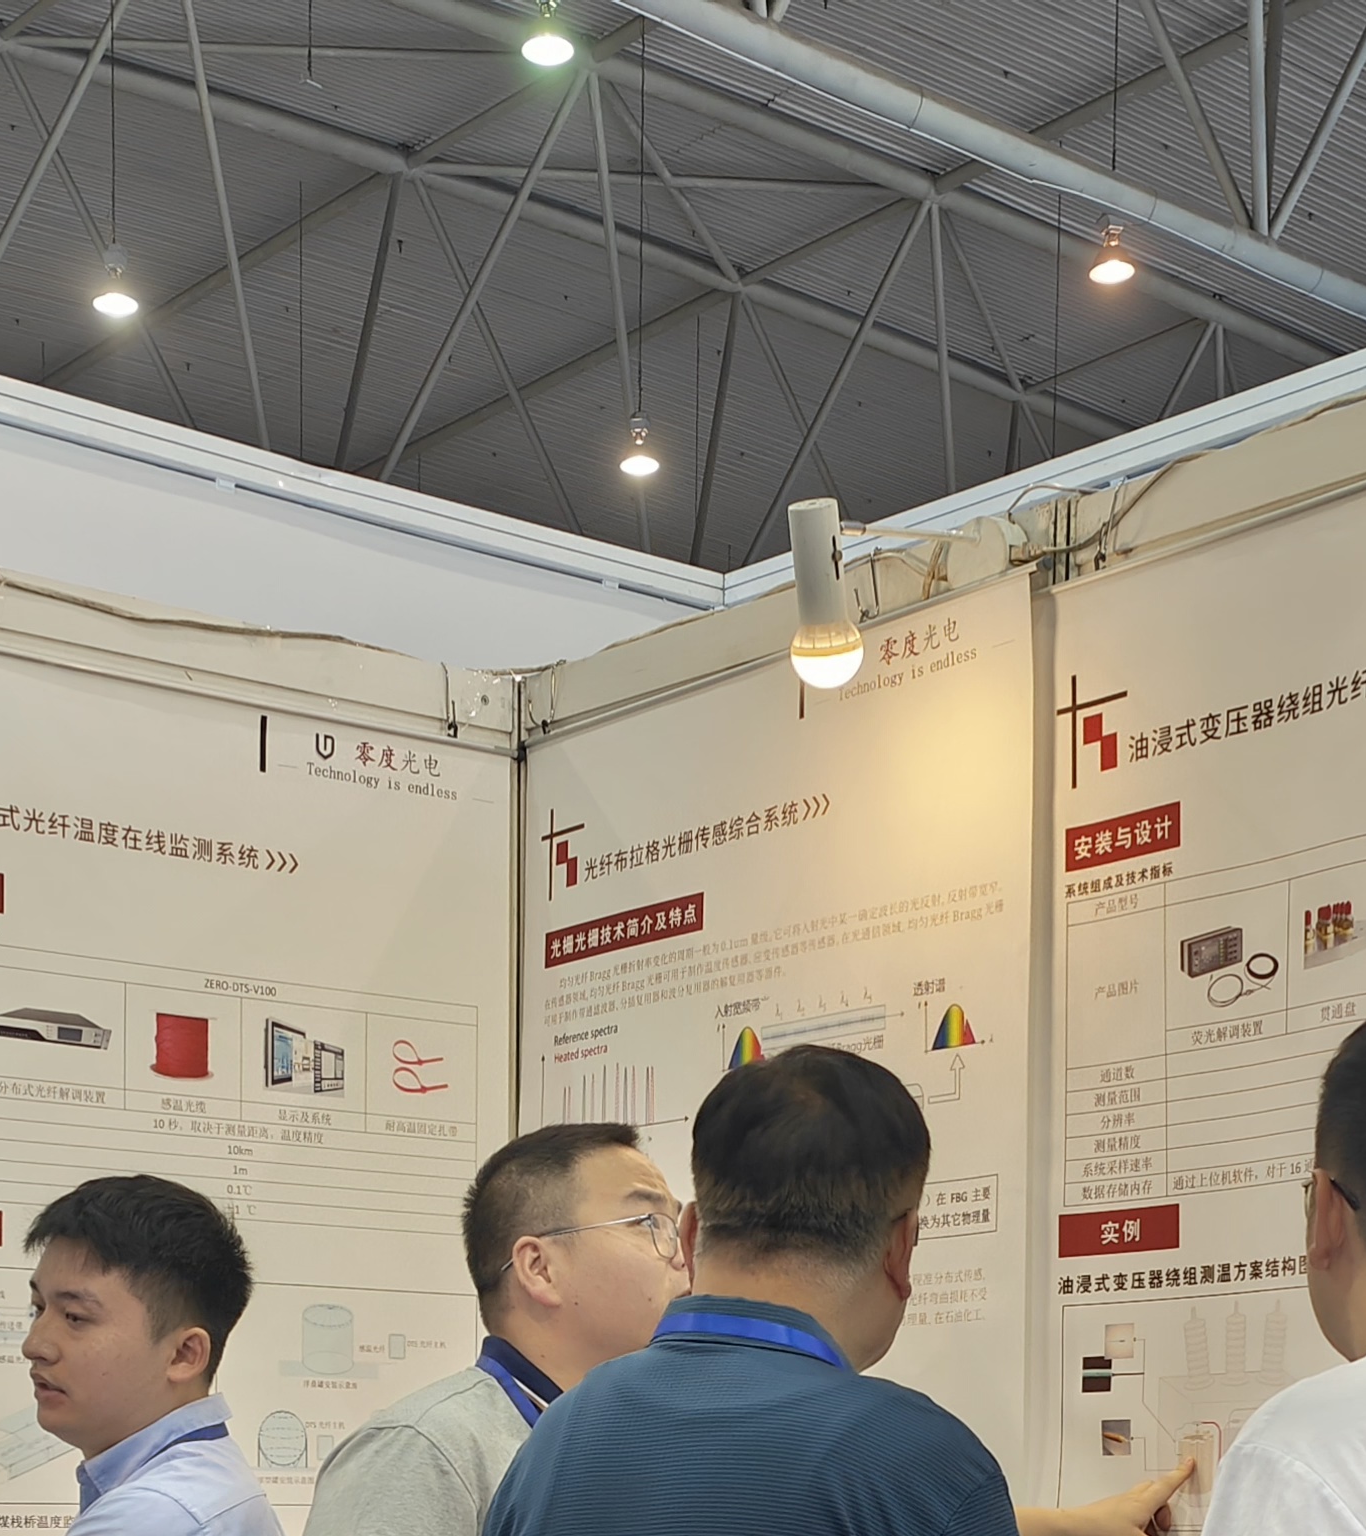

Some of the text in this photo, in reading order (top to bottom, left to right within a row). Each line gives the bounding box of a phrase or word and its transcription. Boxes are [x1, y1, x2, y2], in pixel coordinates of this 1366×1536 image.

[877, 617, 961, 668] 零度光电
[837, 646, 979, 702] Technology is endless
[354, 741, 442, 778] 零度光电
[306, 761, 458, 802] Technology is endless
[583, 800, 799, 882] 光纤布拉格光栅传感综合系统
[1073, 814, 1173, 862] 安装与设计
[1064, 861, 1174, 899] 系统组成及技术指标
[1093, 893, 1139, 918] 产品型号
[549, 901, 698, 960] 光栅光栅技术简介及特点
[203, 977, 278, 998] ZERO-DTS-V100
[1093, 978, 1140, 1001] 产品图片
[553, 1023, 619, 1047] Reference spectra
[1190, 1019, 1264, 1047] 荧光解调装置
[553, 1043, 608, 1065] Heated spectra
[1099, 1064, 1136, 1085] 通道数
[160, 1097, 207, 1115] 感温光缆
[1093, 1086, 1142, 1108] 测量范围
[152, 1118, 166, 1131] 10
[278, 1108, 333, 1127] 显示及系统
[384, 1118, 459, 1138] 耐高温固定扎带
[1099, 1111, 1136, 1131] 分辨率
[226, 1143, 254, 1158] 10km
[1093, 1133, 1142, 1155] 测量精度
[232, 1164, 249, 1177] 1m
[1081, 1155, 1154, 1178] 系统采样速率
[1289, 1161, 1303, 1175] 16
[950, 1185, 991, 1204] FBG 主要
[1080, 1179, 1154, 1201] 数据存储内存
[1099, 1218, 1142, 1245] 实例
